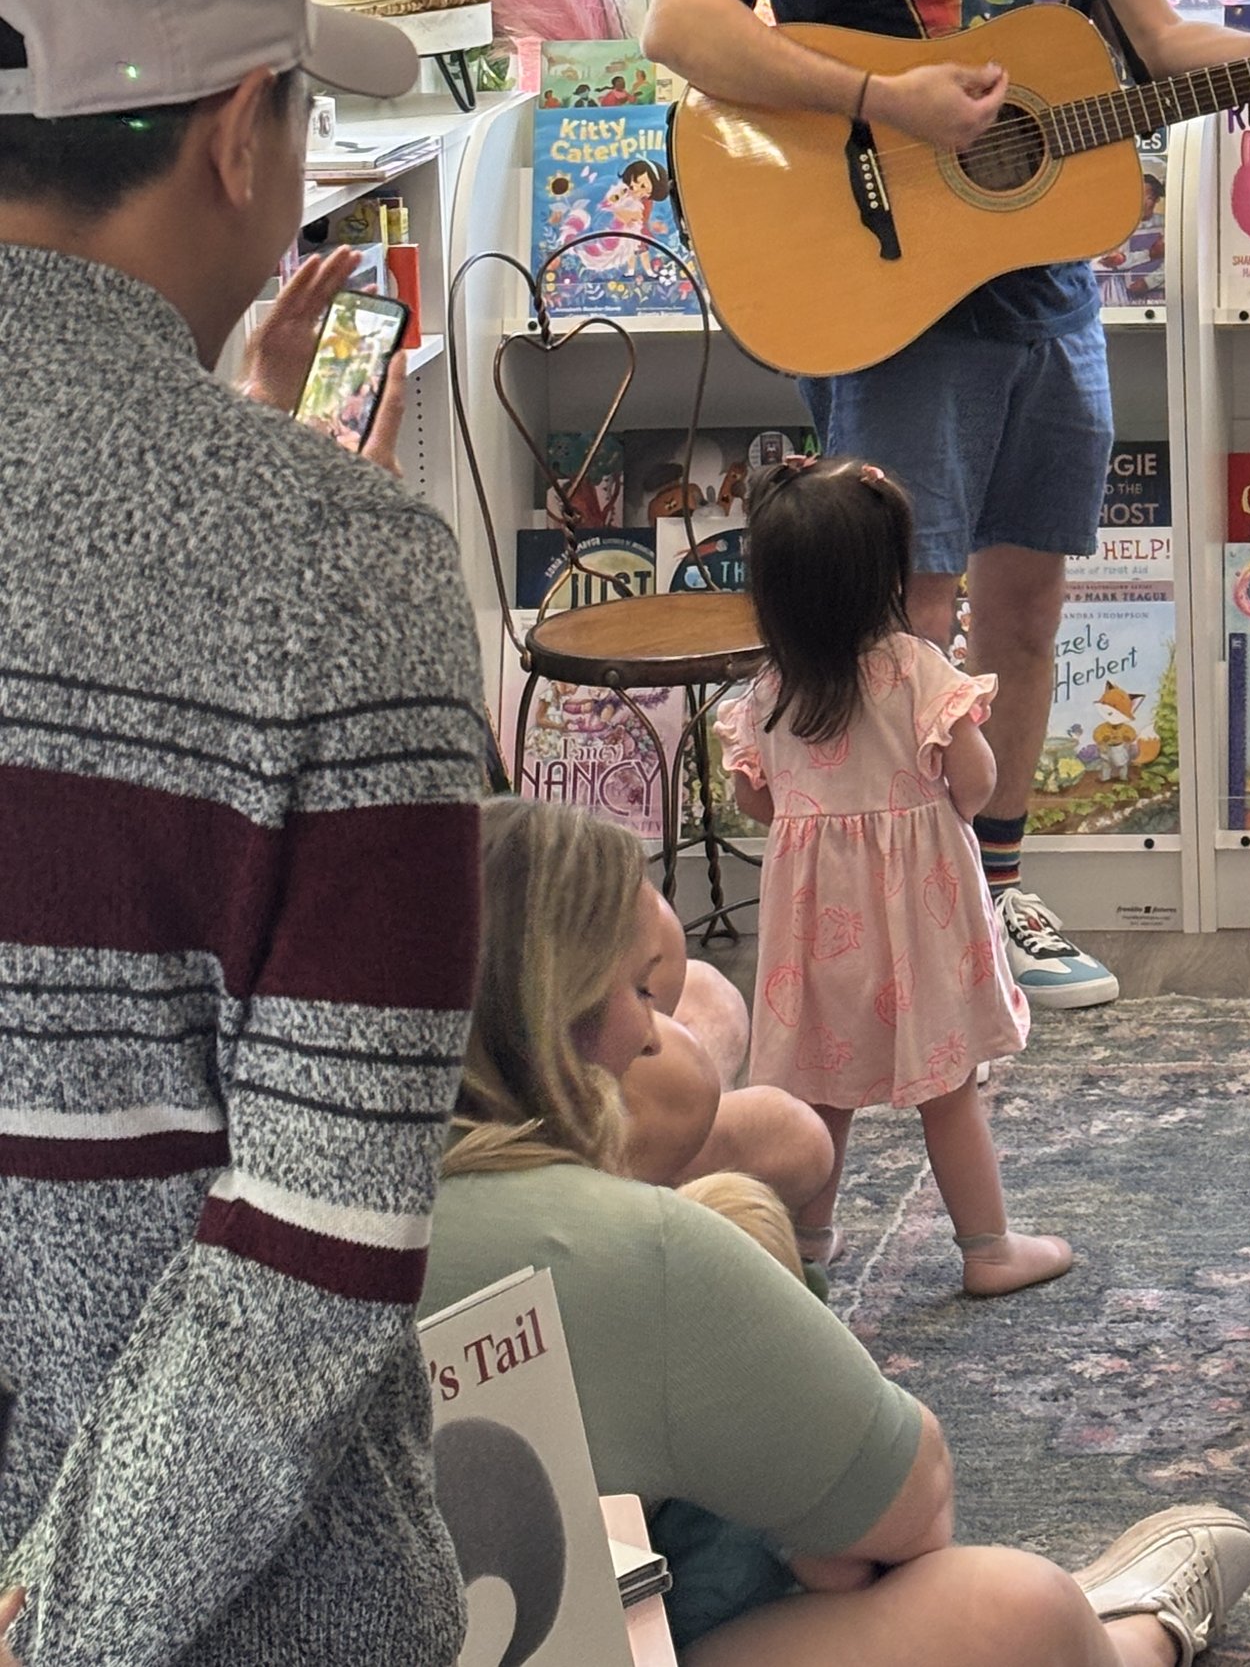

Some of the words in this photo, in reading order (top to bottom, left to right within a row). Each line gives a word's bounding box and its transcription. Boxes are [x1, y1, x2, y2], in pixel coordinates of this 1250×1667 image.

[559, 117, 627, 141] Kitty
[551, 129, 666, 163] Caterpill
[1118, 483, 1143, 494] THE
[1100, 502, 1159, 525] HOST
[1102, 538, 1171, 561] HELP!
[1085, 592, 1118, 602] MARK
[1123, 592, 1167, 602] TEAGUE
[1096, 633, 1110, 651] &
[1053, 646, 1138, 703] Herbert
[560, 737, 625, 762] Fancy
[522, 760, 663, 817] NANCY
[431, 1359, 460, 1401] 's
[464, 1306, 549, 1387] Tail
